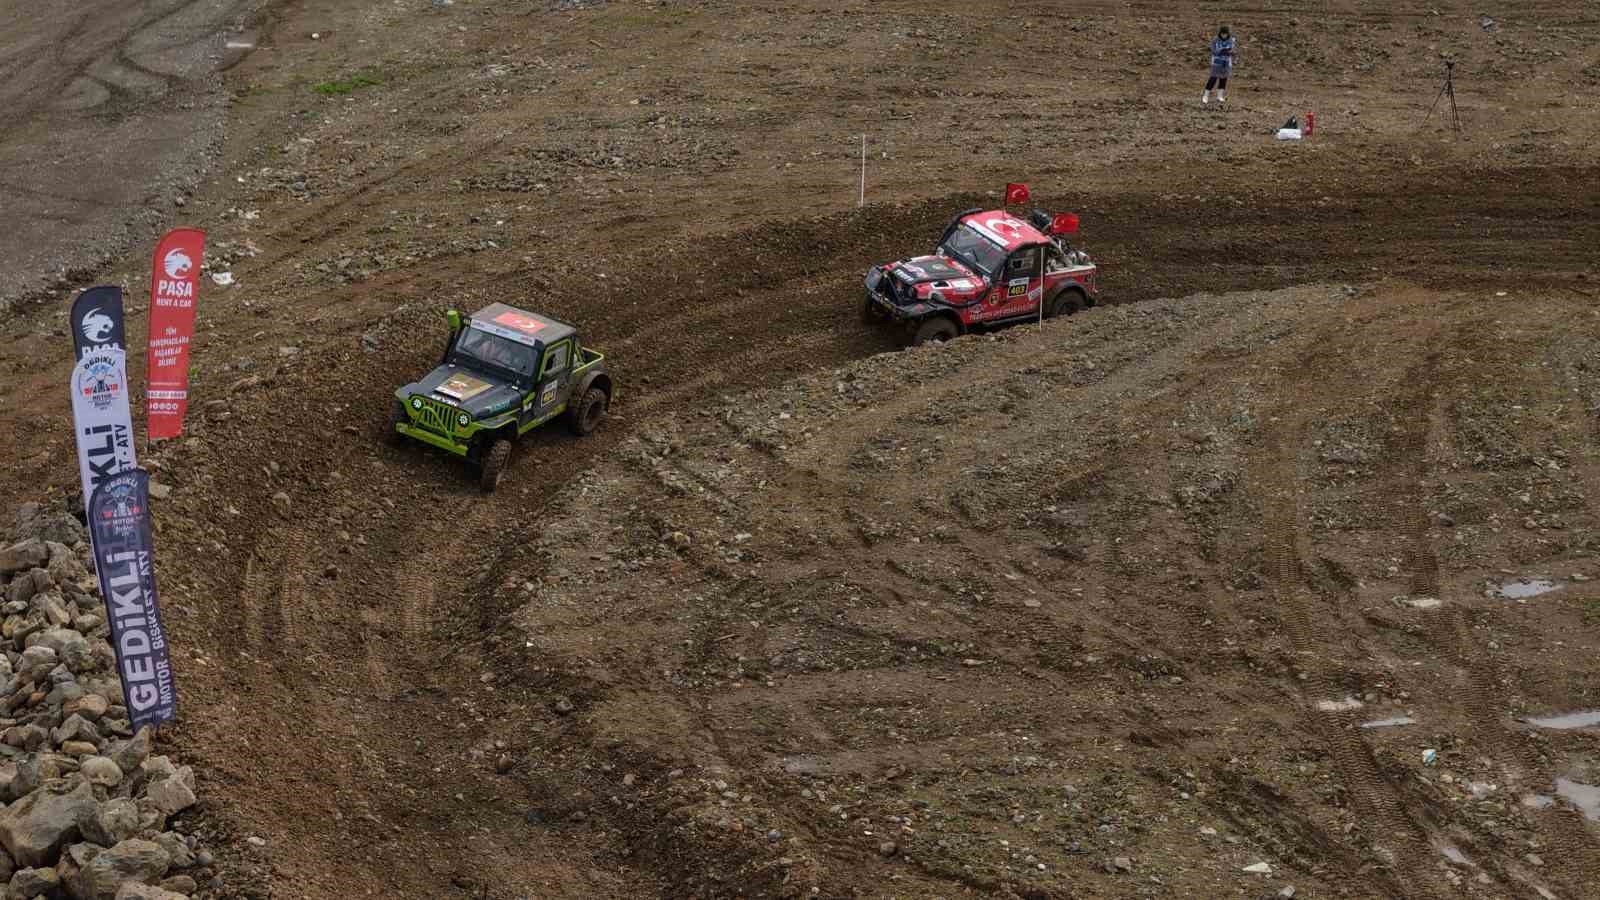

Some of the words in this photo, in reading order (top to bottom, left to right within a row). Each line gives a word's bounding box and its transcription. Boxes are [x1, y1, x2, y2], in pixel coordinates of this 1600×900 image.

[156, 297, 172, 307] RENT
[180, 299, 192, 308] CAR
[114, 424, 129, 448] ATV
[138, 551, 150, 576] ATV
[156, 659, 173, 705] MOTOR
